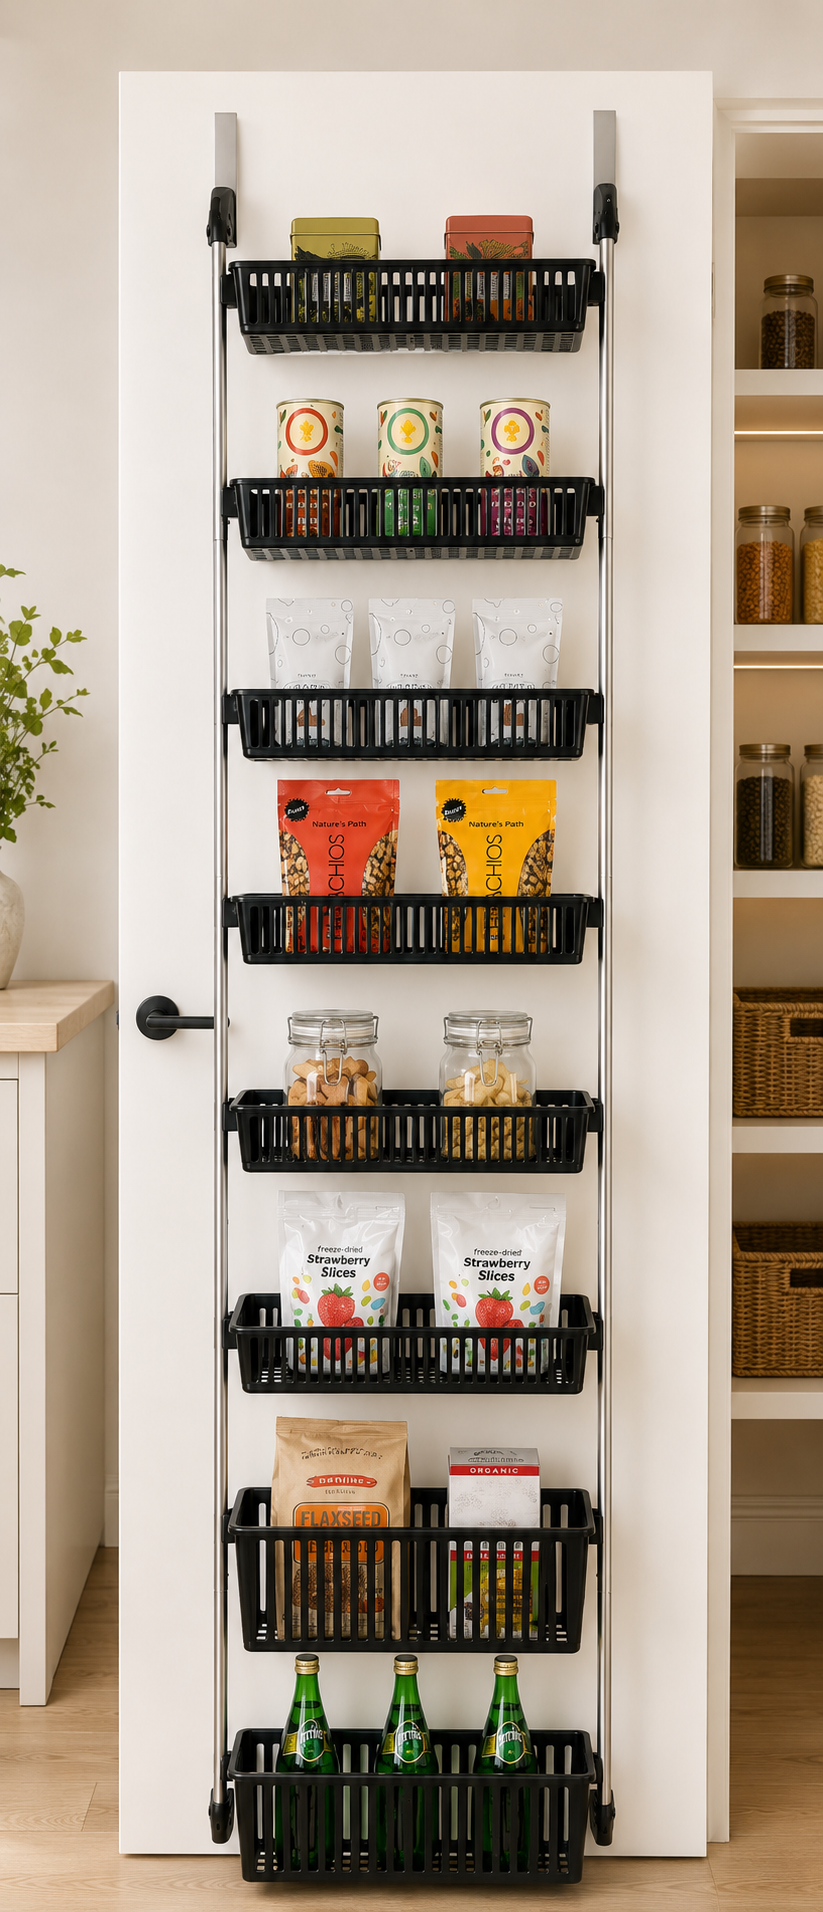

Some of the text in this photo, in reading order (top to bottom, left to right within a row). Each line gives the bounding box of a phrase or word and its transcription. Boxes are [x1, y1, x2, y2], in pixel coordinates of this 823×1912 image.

[312, 820, 367, 828] Nature's Path
[468, 820, 524, 828] Nature's Path
[317, 1245, 363, 1253] freeze-dried
[473, 1248, 522, 1256] freeze-dried
[306, 1253, 371, 1267] Strawberry
[463, 1257, 531, 1271] Strawberry
[320, 1266, 356, 1278] Slices
[478, 1270, 515, 1282] Slices
[301, 1510, 381, 1527] FLAXSEED
